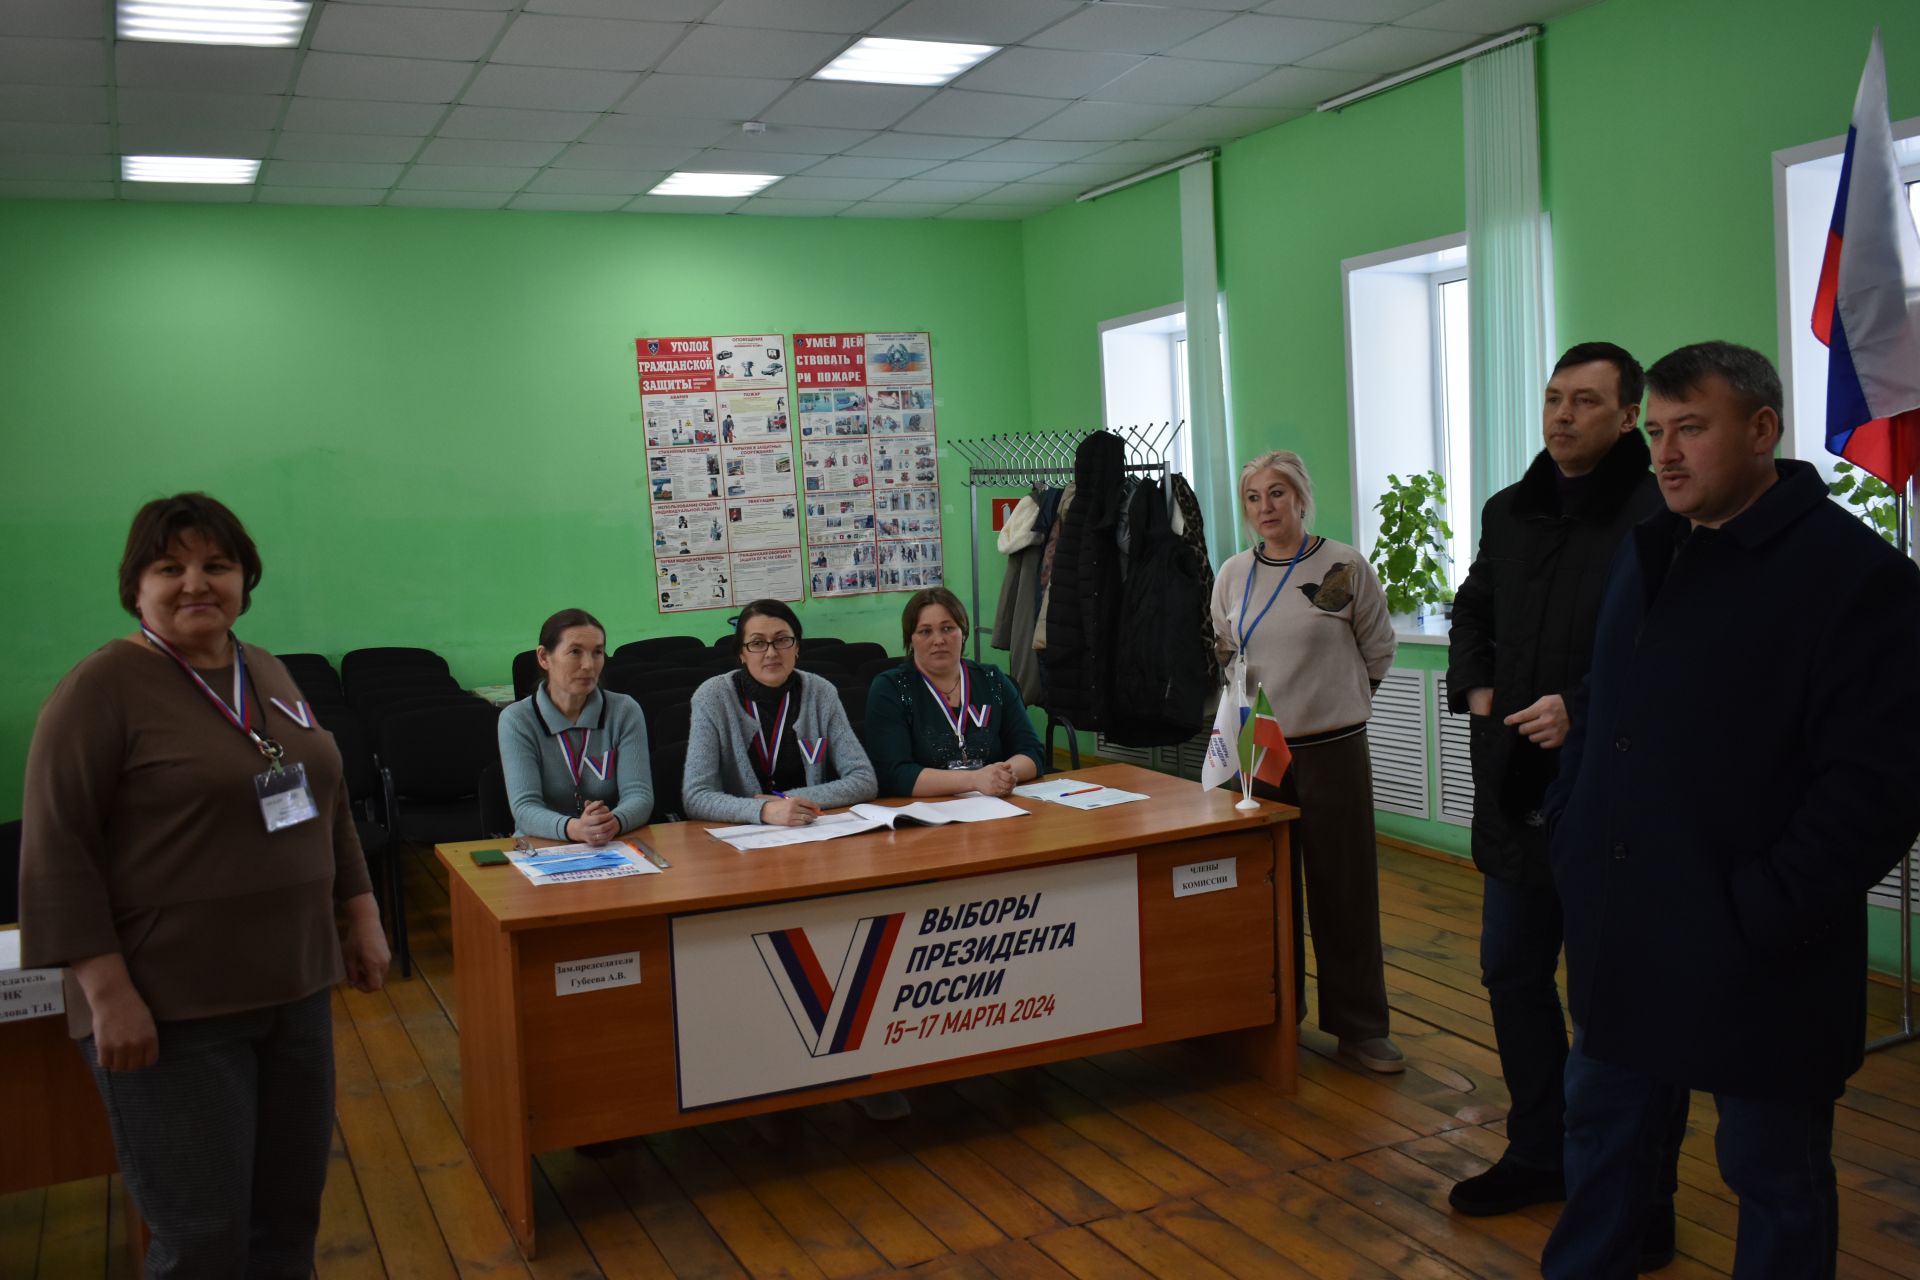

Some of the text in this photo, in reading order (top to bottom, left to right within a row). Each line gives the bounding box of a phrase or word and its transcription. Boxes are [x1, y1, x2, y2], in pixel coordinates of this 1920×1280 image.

[671, 341, 709, 353] УГОЛОК
[806, 336, 837, 348] УМЕЙ
[843, 335, 864, 348] ДЕЙ
[638, 357, 713, 373] ГРАЖДАНСКОЙ
[796, 354, 850, 366] СТВОВАТЬ
[797, 371, 862, 383] РИ ПОЖАРЕ
[643, 379, 692, 392] ЗАЩИТЫ
[1190, 863, 1219, 874] ЧЛЕНЫ
[1182, 876, 1228, 890] КОМИССИИ
[918, 892, 1042, 936] ВЫБОРЫ
[905, 922, 1077, 974] ПРЕЗИДЕНТА
[892, 969, 1006, 1013] РОССИИ
[940, 1003, 1005, 1037] МАРТА
[1008, 993, 1057, 1025] 2024
